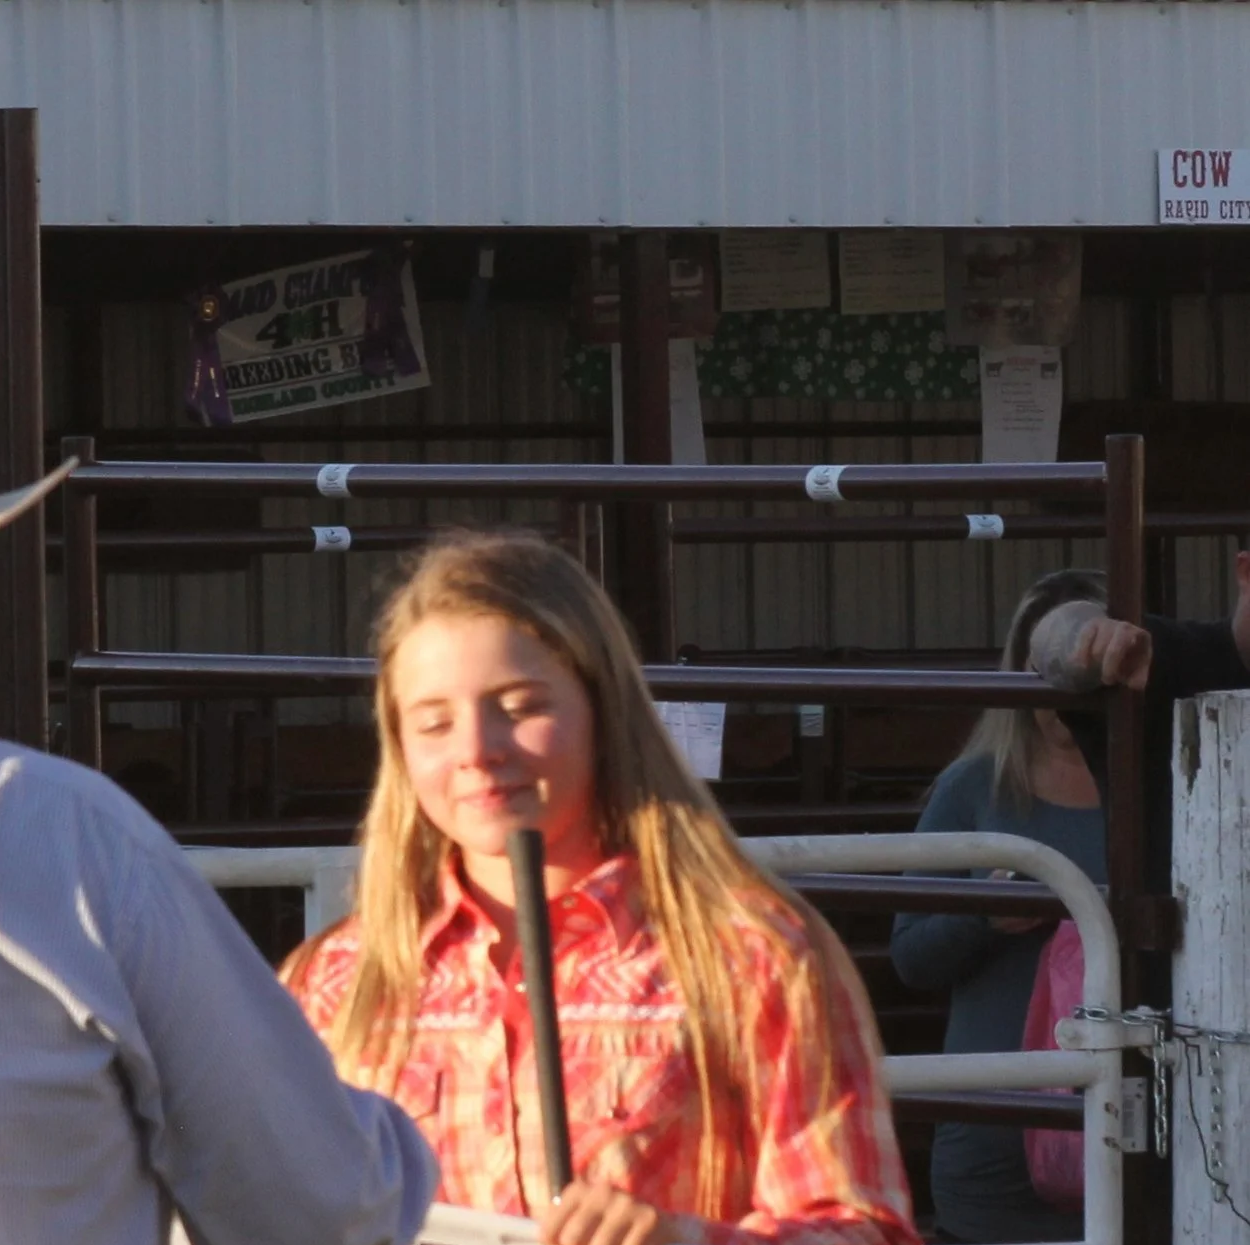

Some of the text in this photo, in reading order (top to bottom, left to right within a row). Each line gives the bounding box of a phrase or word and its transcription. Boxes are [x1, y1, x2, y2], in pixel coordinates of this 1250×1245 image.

[1173, 150, 1232, 188] COW
[1165, 200, 1209, 219] RAPID
[223, 347, 332, 390] REEDING
